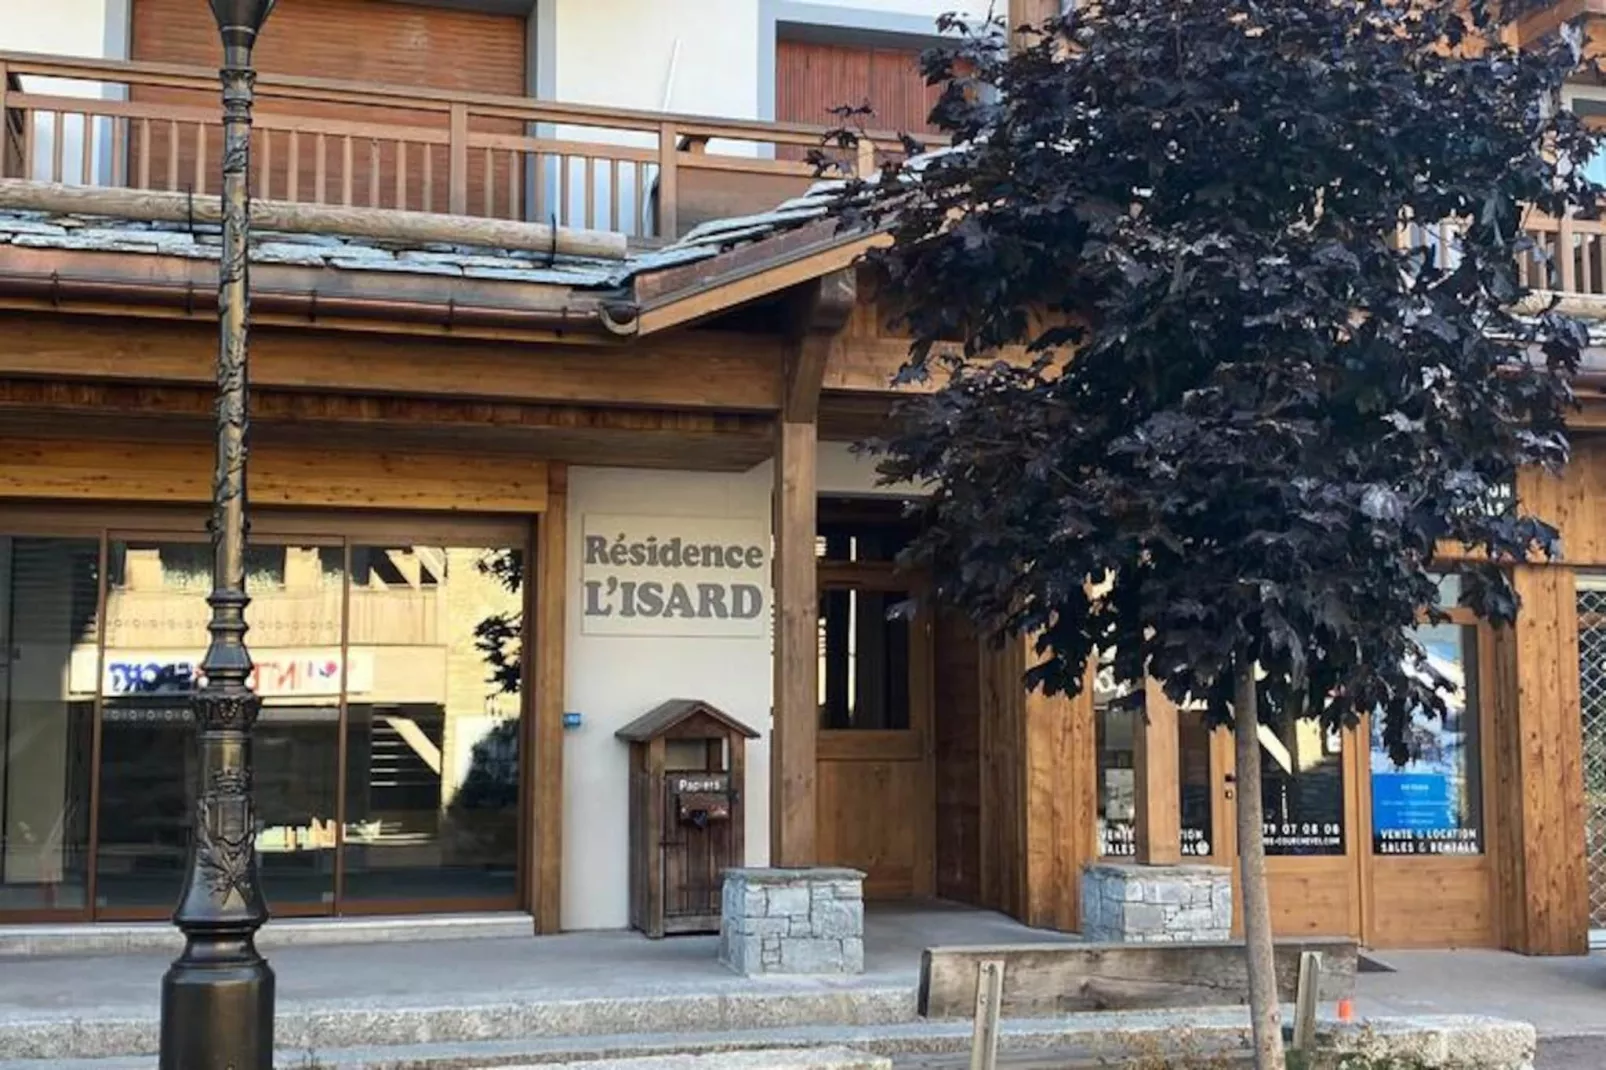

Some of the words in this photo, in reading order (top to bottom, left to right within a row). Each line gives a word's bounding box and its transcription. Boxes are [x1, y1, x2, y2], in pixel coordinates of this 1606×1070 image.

[585, 533, 763, 568] Résidence
[585, 576, 763, 619] L'ISARD
[1381, 828, 1412, 840] VENTE
[1427, 828, 1477, 840] LOCATION
[1381, 841, 1414, 854] SALES
